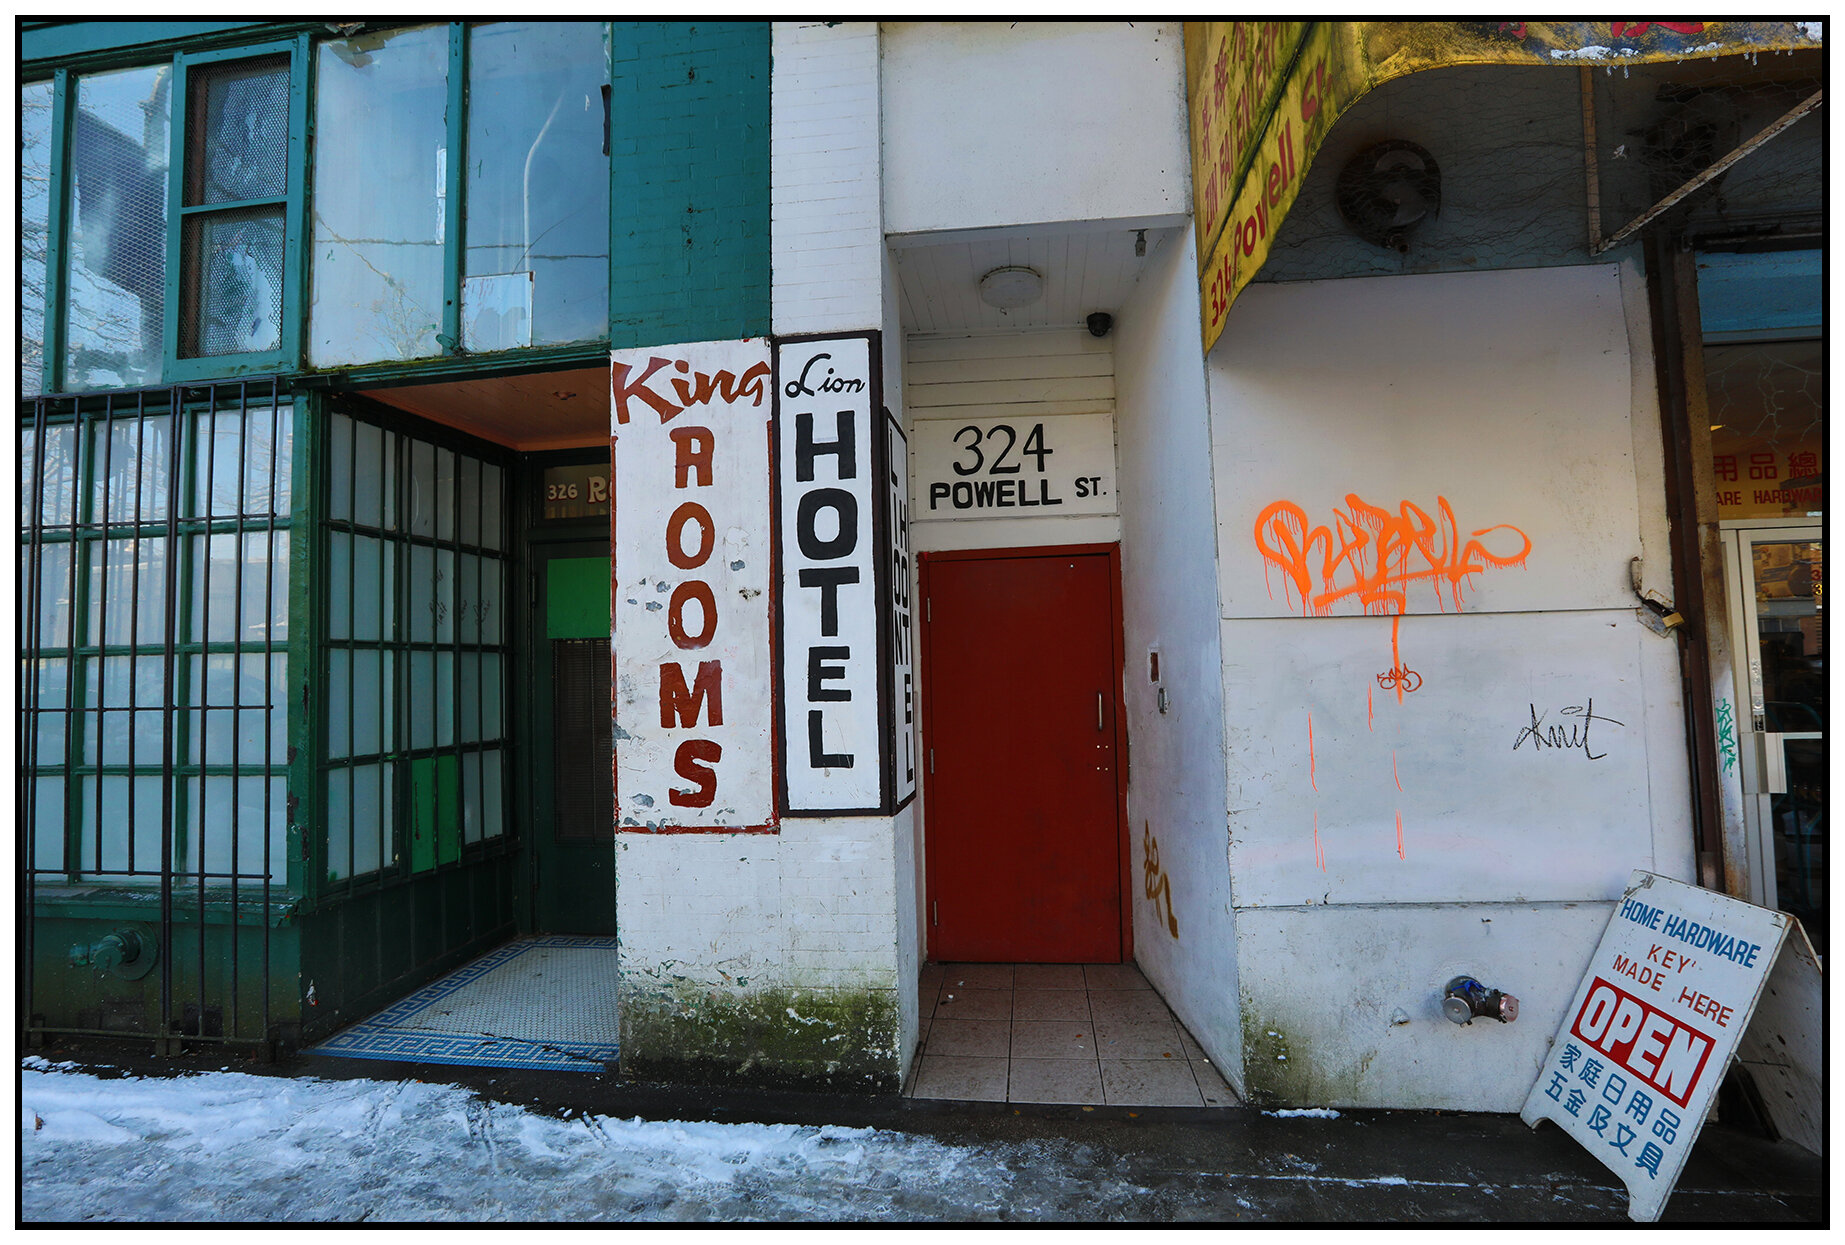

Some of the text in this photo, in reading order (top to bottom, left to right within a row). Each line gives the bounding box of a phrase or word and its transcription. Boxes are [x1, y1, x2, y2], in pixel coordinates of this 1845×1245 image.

[1219, 119, 1234, 200] FAI
[1211, 253, 1232, 327] 324
[1233, 116, 1295, 277] Powell
[612, 356, 771, 424] King
[784, 353, 866, 398] Lion
[547, 476, 613, 504] 326 R
[930, 477, 1107, 510] POWELL ST.
[952, 423, 1053, 476] 324
[795, 409, 860, 769] HOTEL
[889, 428, 904, 665] LION
[659, 426, 724, 808] ROOMS
[899, 499, 914, 784] HOTEL
[1619, 898, 1761, 969] HOME HARDWARE
[1612, 955, 1734, 1028] MADE HERE
[1578, 985, 1708, 1100] OPEN
[1544, 1071, 1664, 1180] 五金及文具
[1559, 1043, 1681, 1145] 家庭日用品
